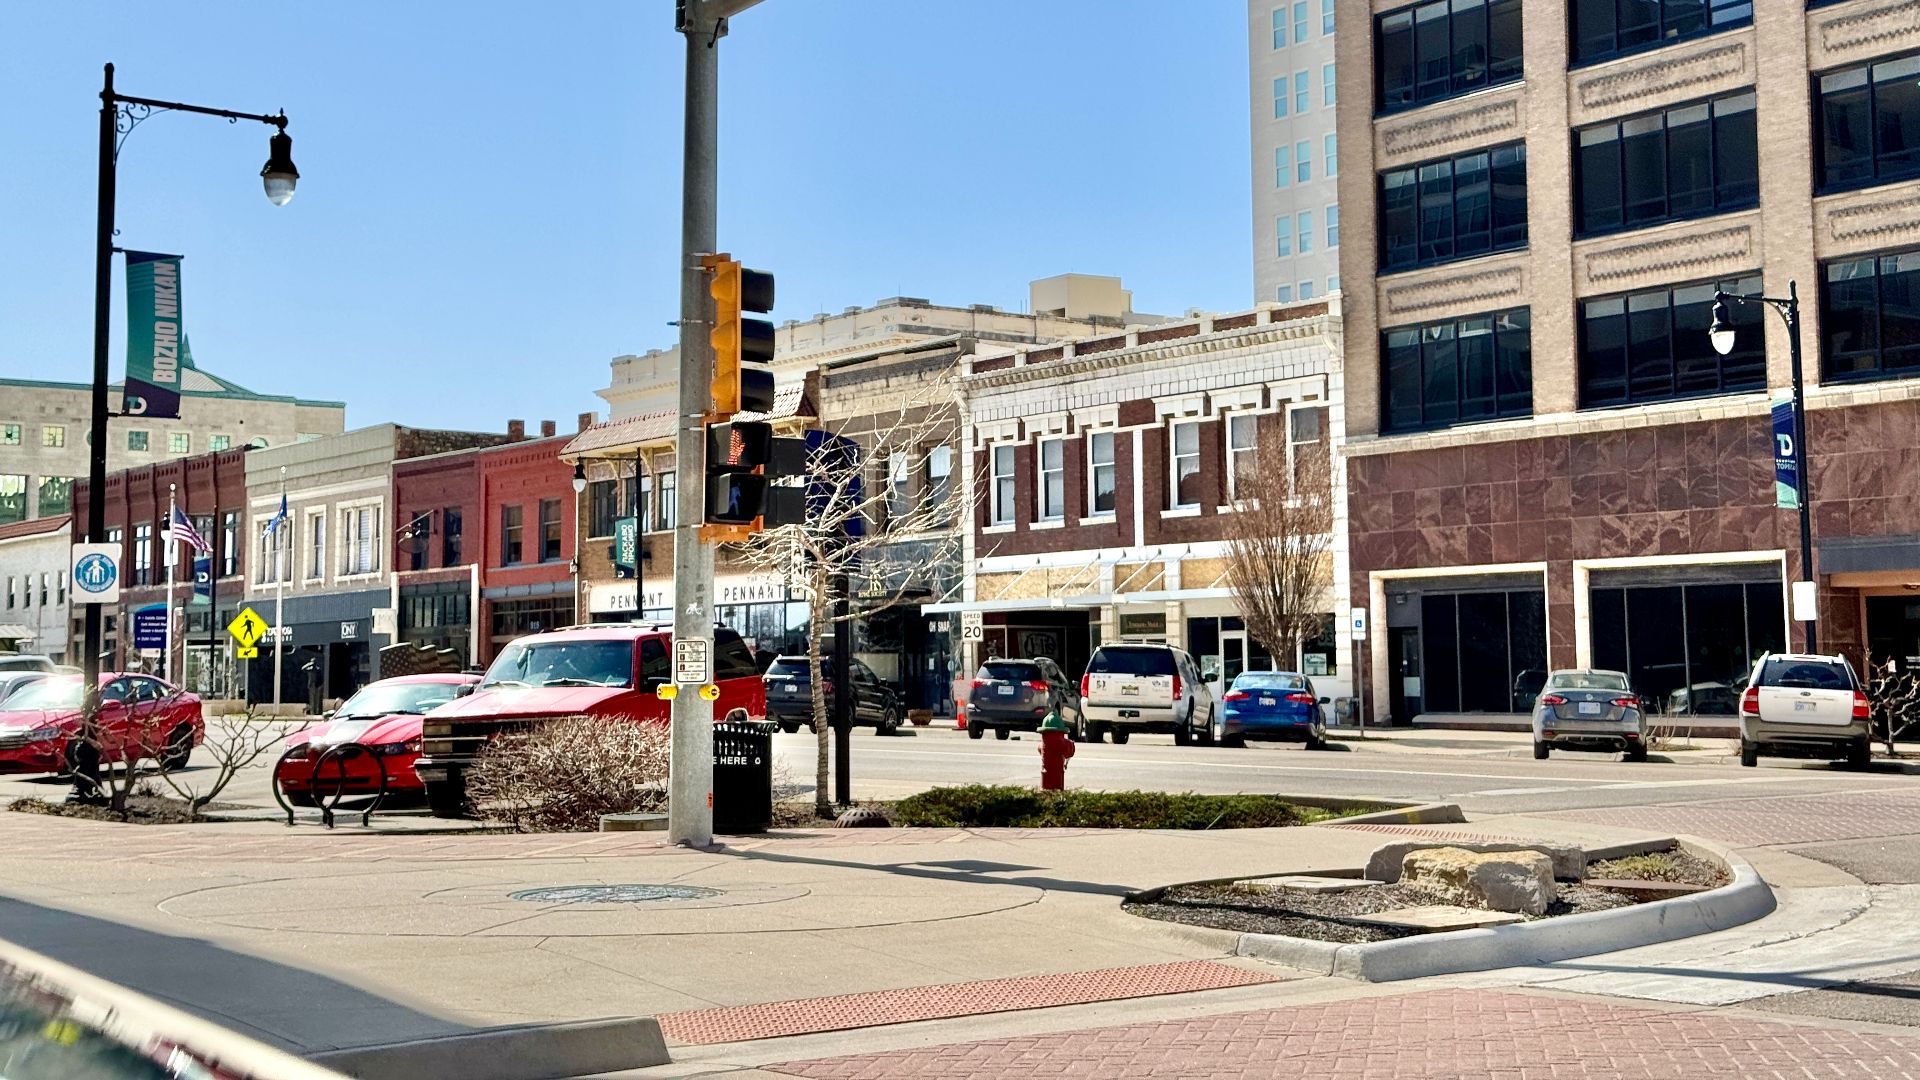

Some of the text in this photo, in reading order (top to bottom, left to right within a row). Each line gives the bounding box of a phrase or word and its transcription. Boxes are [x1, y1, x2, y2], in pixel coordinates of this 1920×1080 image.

[152, 262, 178, 383] BOZHO NIKAN
[610, 592, 663, 609] PENNANT
[724, 584, 783, 601] PENNANT
[964, 626, 981, 638] 20
[720, 756, 748, 765] HERE
